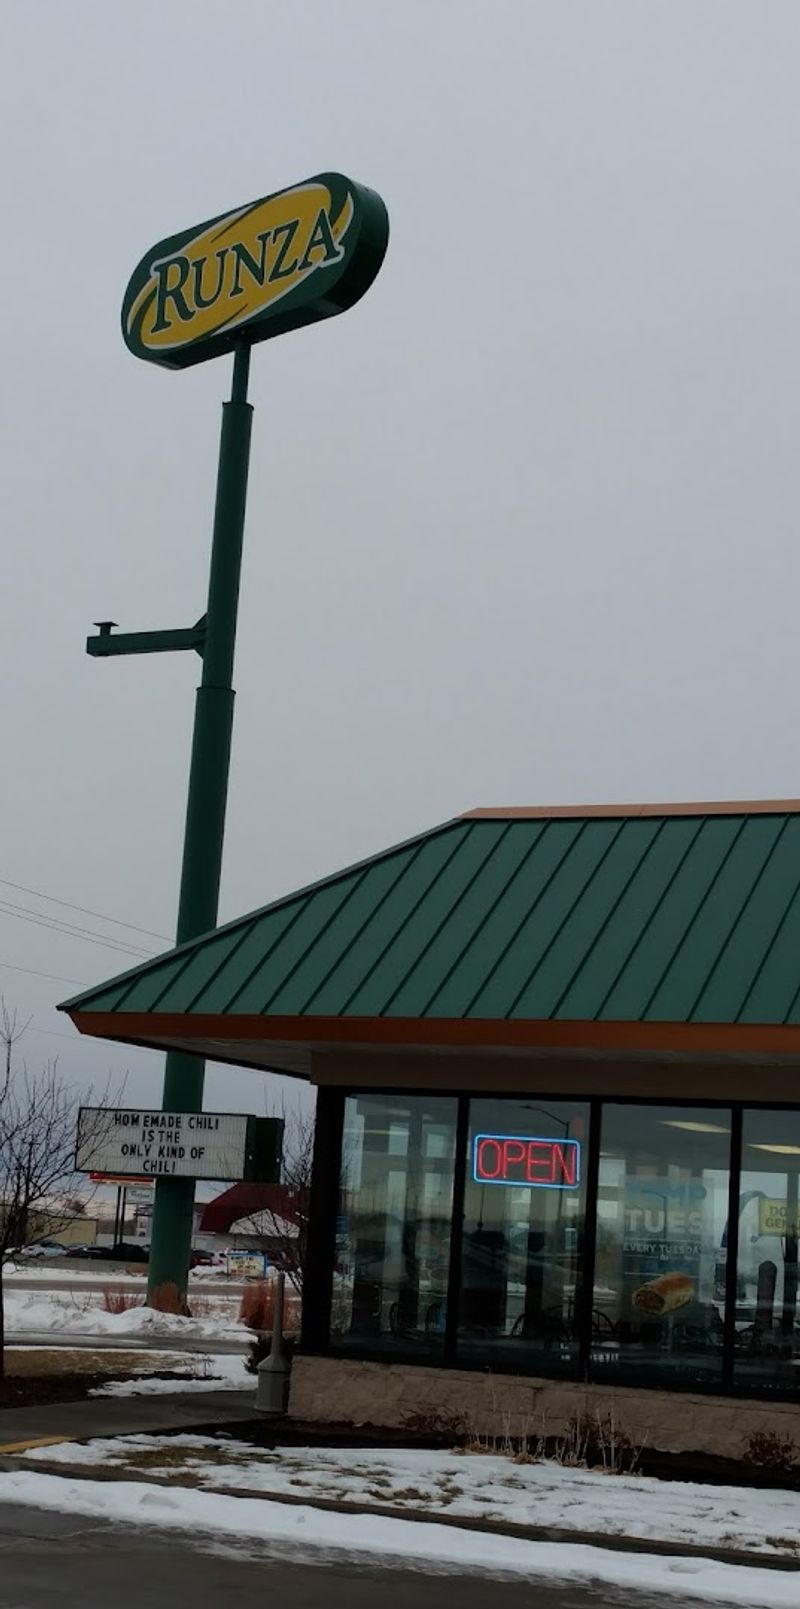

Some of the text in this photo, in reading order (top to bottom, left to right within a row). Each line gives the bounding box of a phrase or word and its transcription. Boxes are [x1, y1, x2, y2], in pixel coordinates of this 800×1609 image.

[150, 207, 343, 334] RUNZA
[188, 1116, 219, 1130] CHILI
[142, 1130, 180, 1143] IS THE
[121, 1144, 206, 1159] ONLY KIND OF
[477, 1138, 578, 1185] OPEN
[623, 1209, 703, 1234] TUES
[623, 1242, 657, 1253] EVERY
